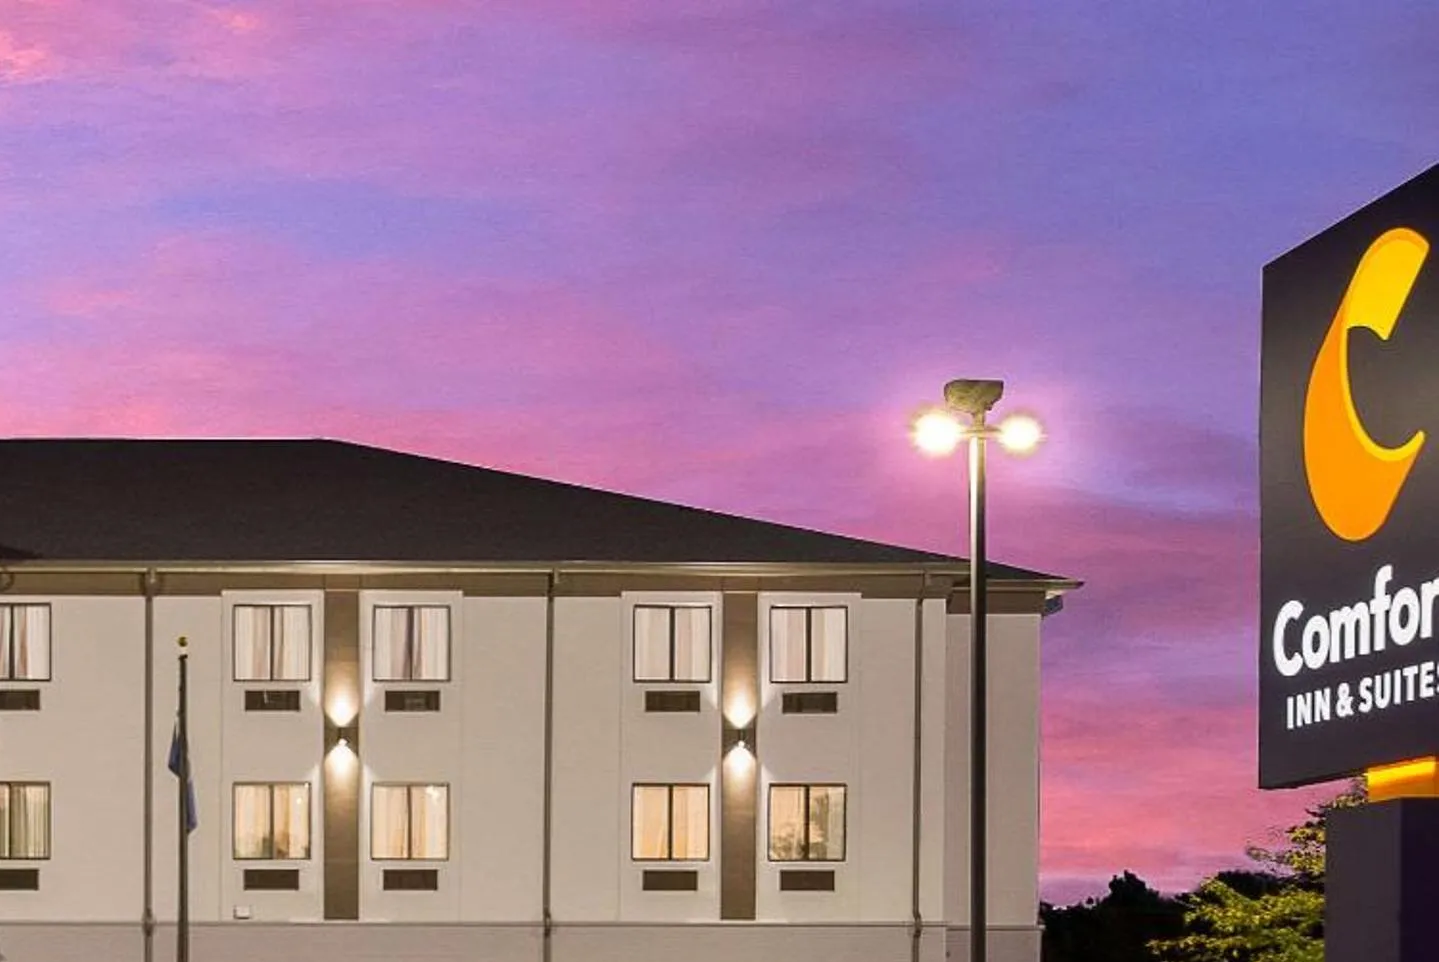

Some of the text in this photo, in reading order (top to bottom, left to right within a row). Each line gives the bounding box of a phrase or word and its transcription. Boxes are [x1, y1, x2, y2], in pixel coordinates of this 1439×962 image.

[1272, 564, 1439, 677] Comfor
[1286, 660, 1439, 730] INN & SUITE
